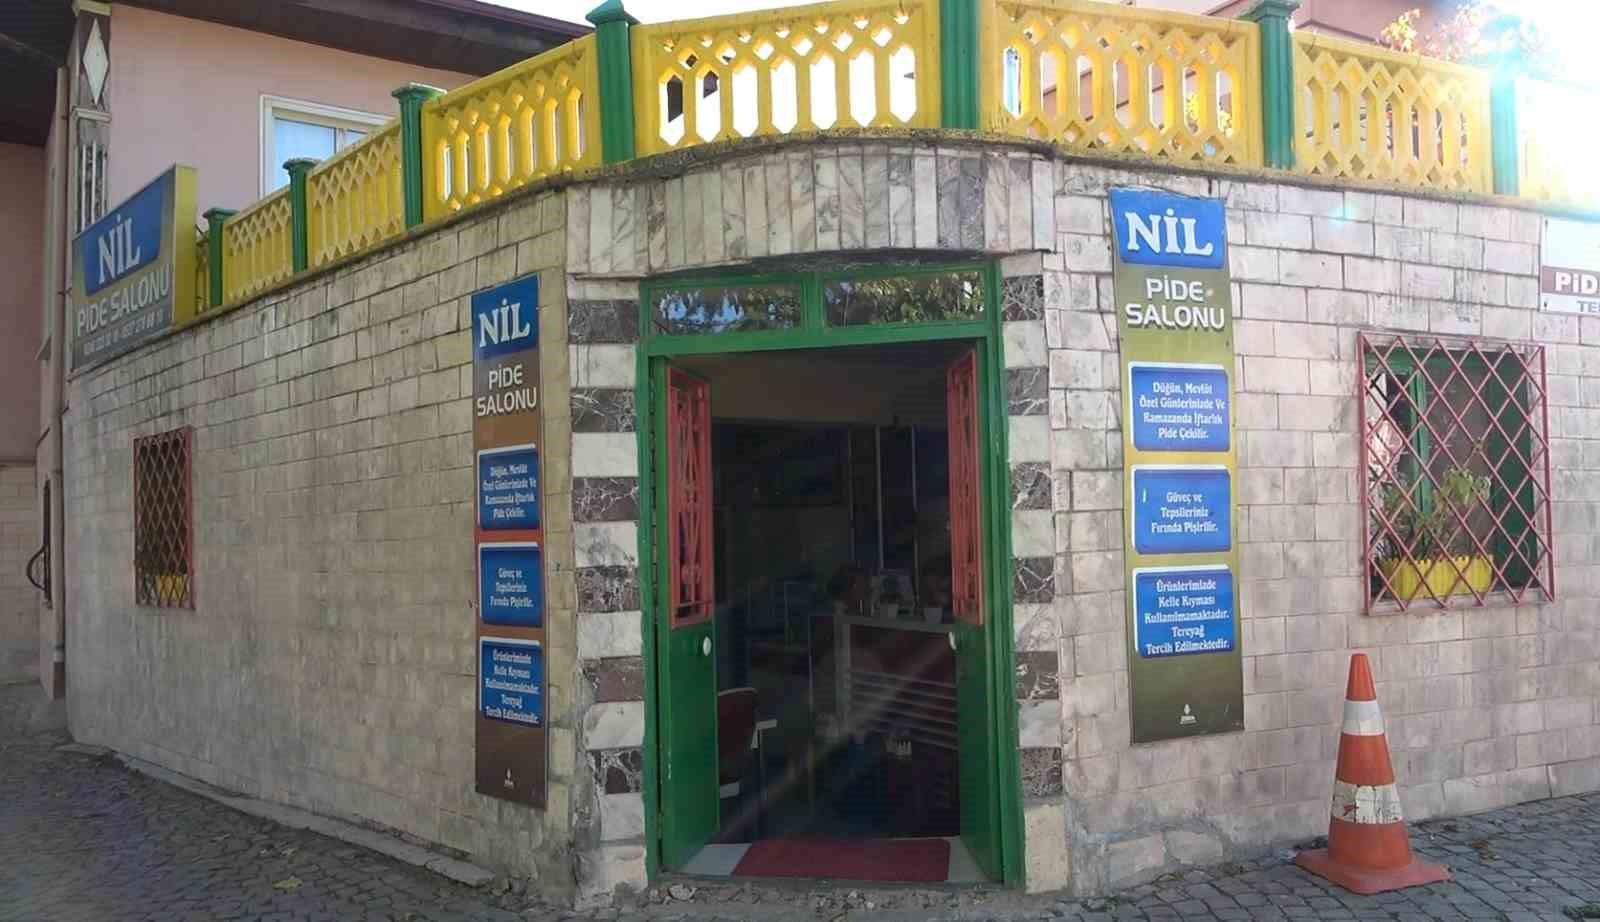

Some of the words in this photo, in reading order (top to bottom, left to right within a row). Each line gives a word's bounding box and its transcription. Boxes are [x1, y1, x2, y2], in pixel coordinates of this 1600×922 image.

[1124, 208, 1214, 256] NİL
[98, 214, 141, 284] NİL
[110, 264, 169, 321] SALONU
[1146, 275, 1204, 302] PİDE
[478, 298, 530, 347] NİL
[1125, 303, 1224, 329] SALONU
[488, 363, 523, 390] PİDE
[476, 386, 537, 416] SALONU
[1145, 642, 1173, 656] Tercih
